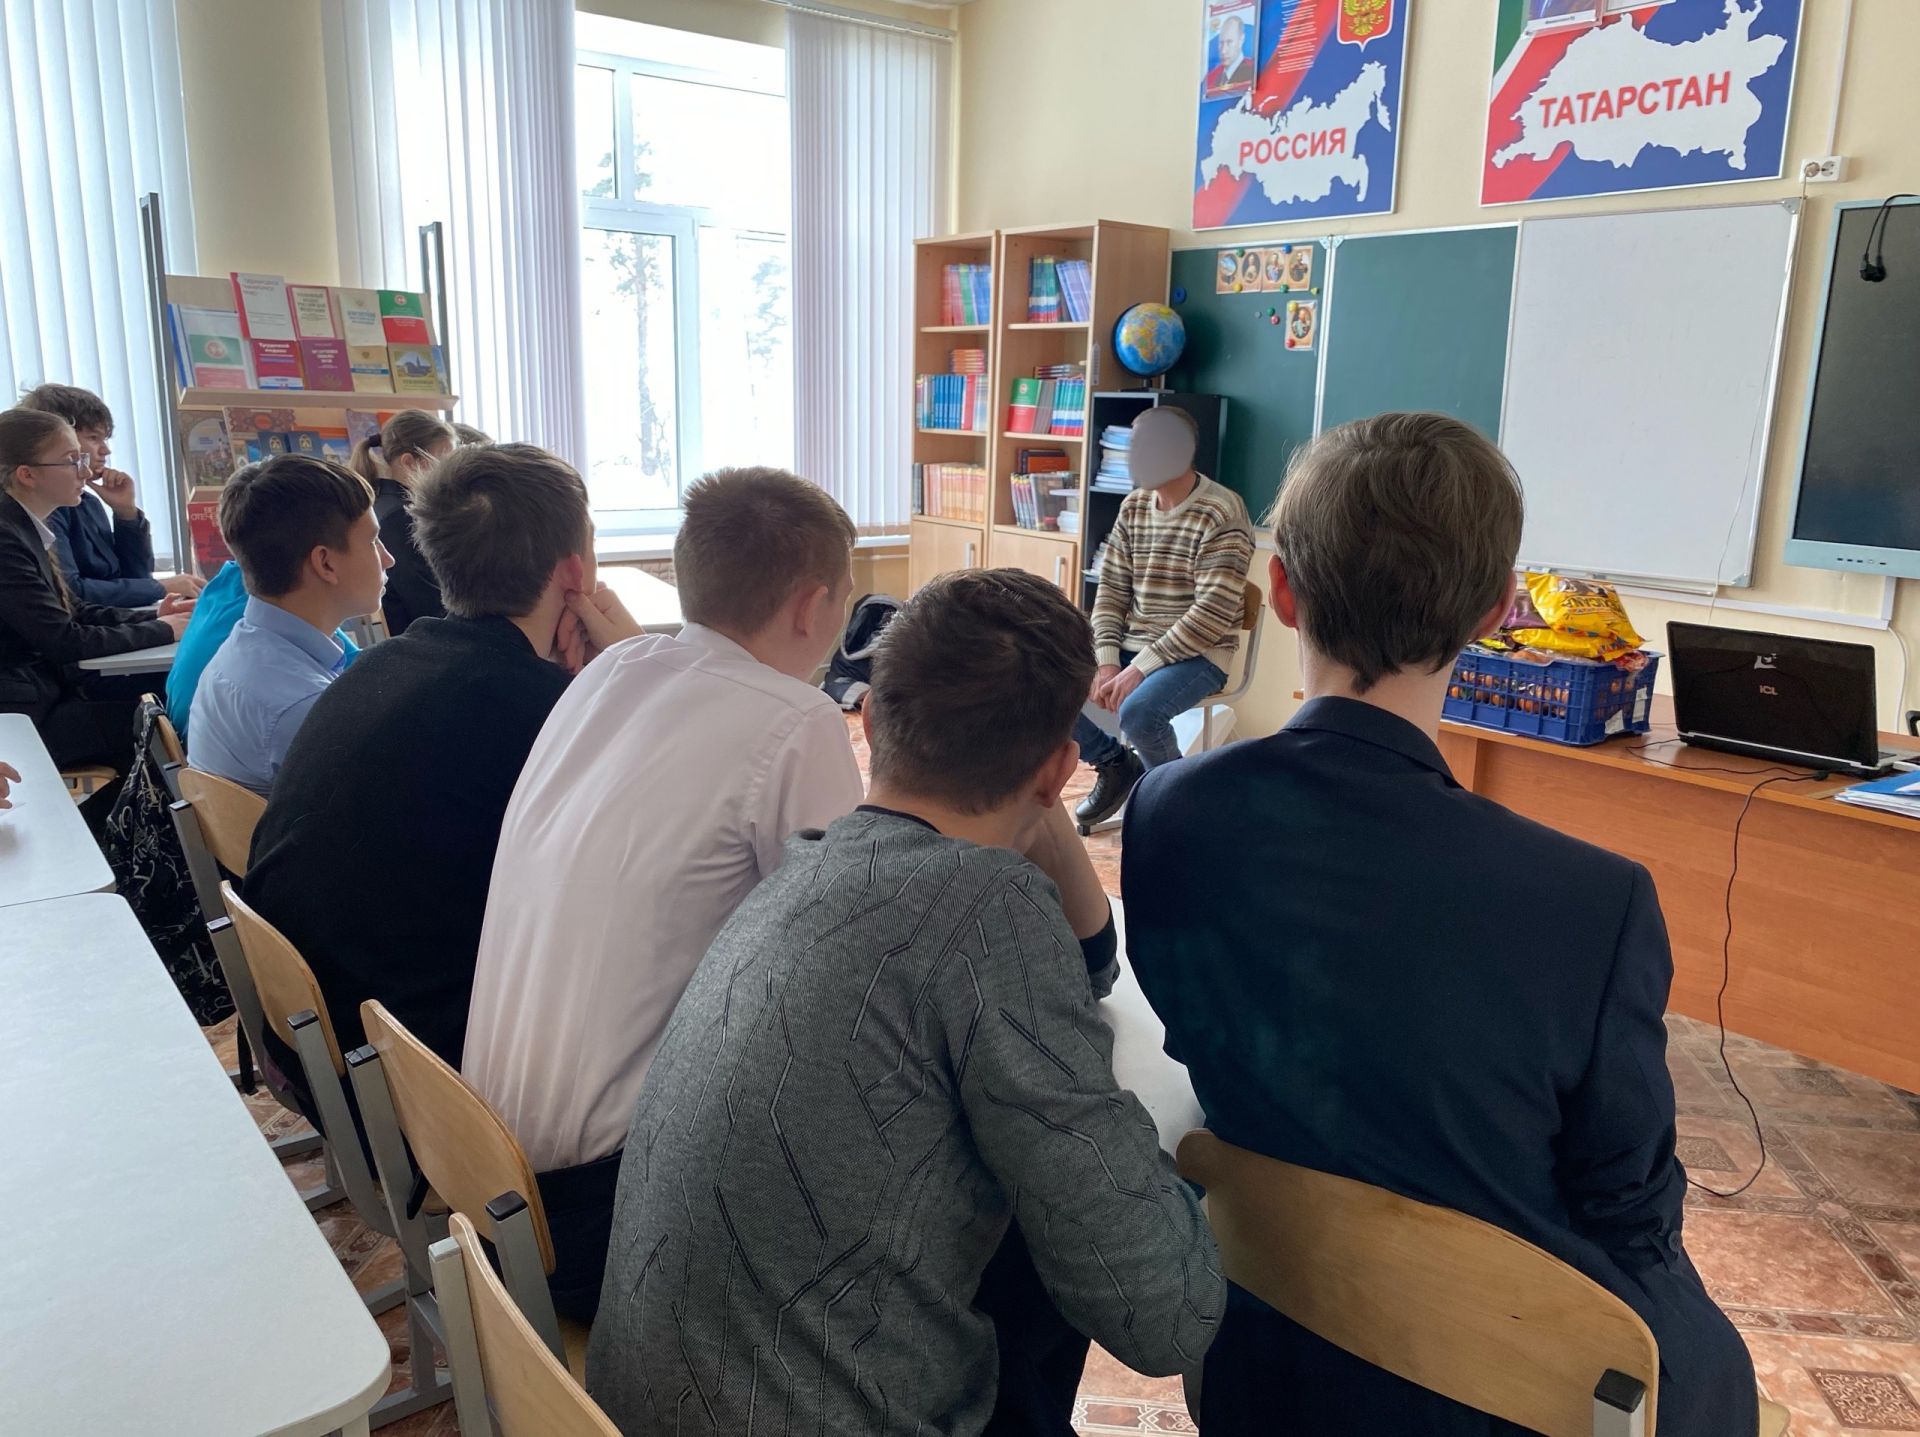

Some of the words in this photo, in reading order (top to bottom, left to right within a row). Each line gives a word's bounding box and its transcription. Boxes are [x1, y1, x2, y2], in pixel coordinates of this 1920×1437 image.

[1539, 71, 1731, 128] ТАТАРСТАН
[1239, 127, 1346, 167] РОССИЯ
[1759, 685, 1778, 695] ICL
